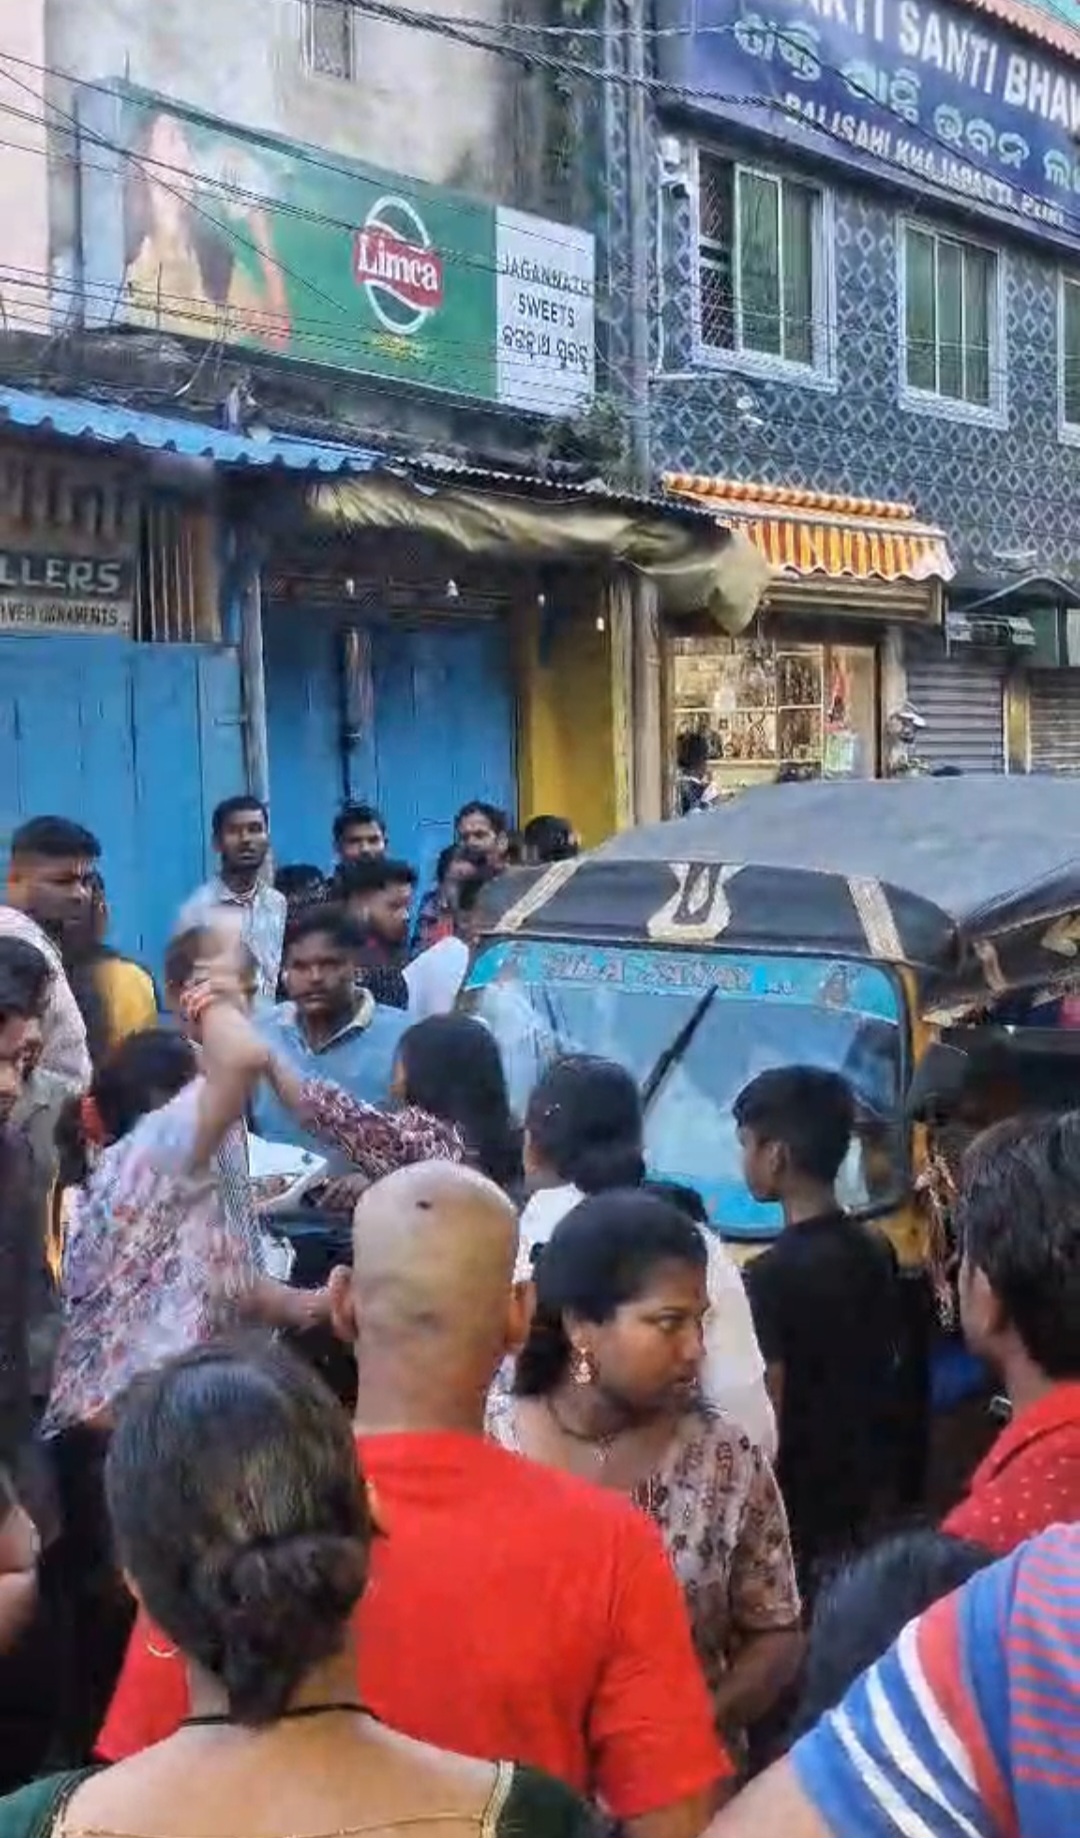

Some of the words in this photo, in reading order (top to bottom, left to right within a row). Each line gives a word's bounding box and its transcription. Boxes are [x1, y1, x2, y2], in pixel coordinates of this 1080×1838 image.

[899, 0, 998, 94] SANTI
[357, 233, 438, 292] Limca
[517, 292, 575, 329] SWEETS
[0, 556, 121, 594] LLERS
[38, 603, 119, 627] ORNAMENTS
